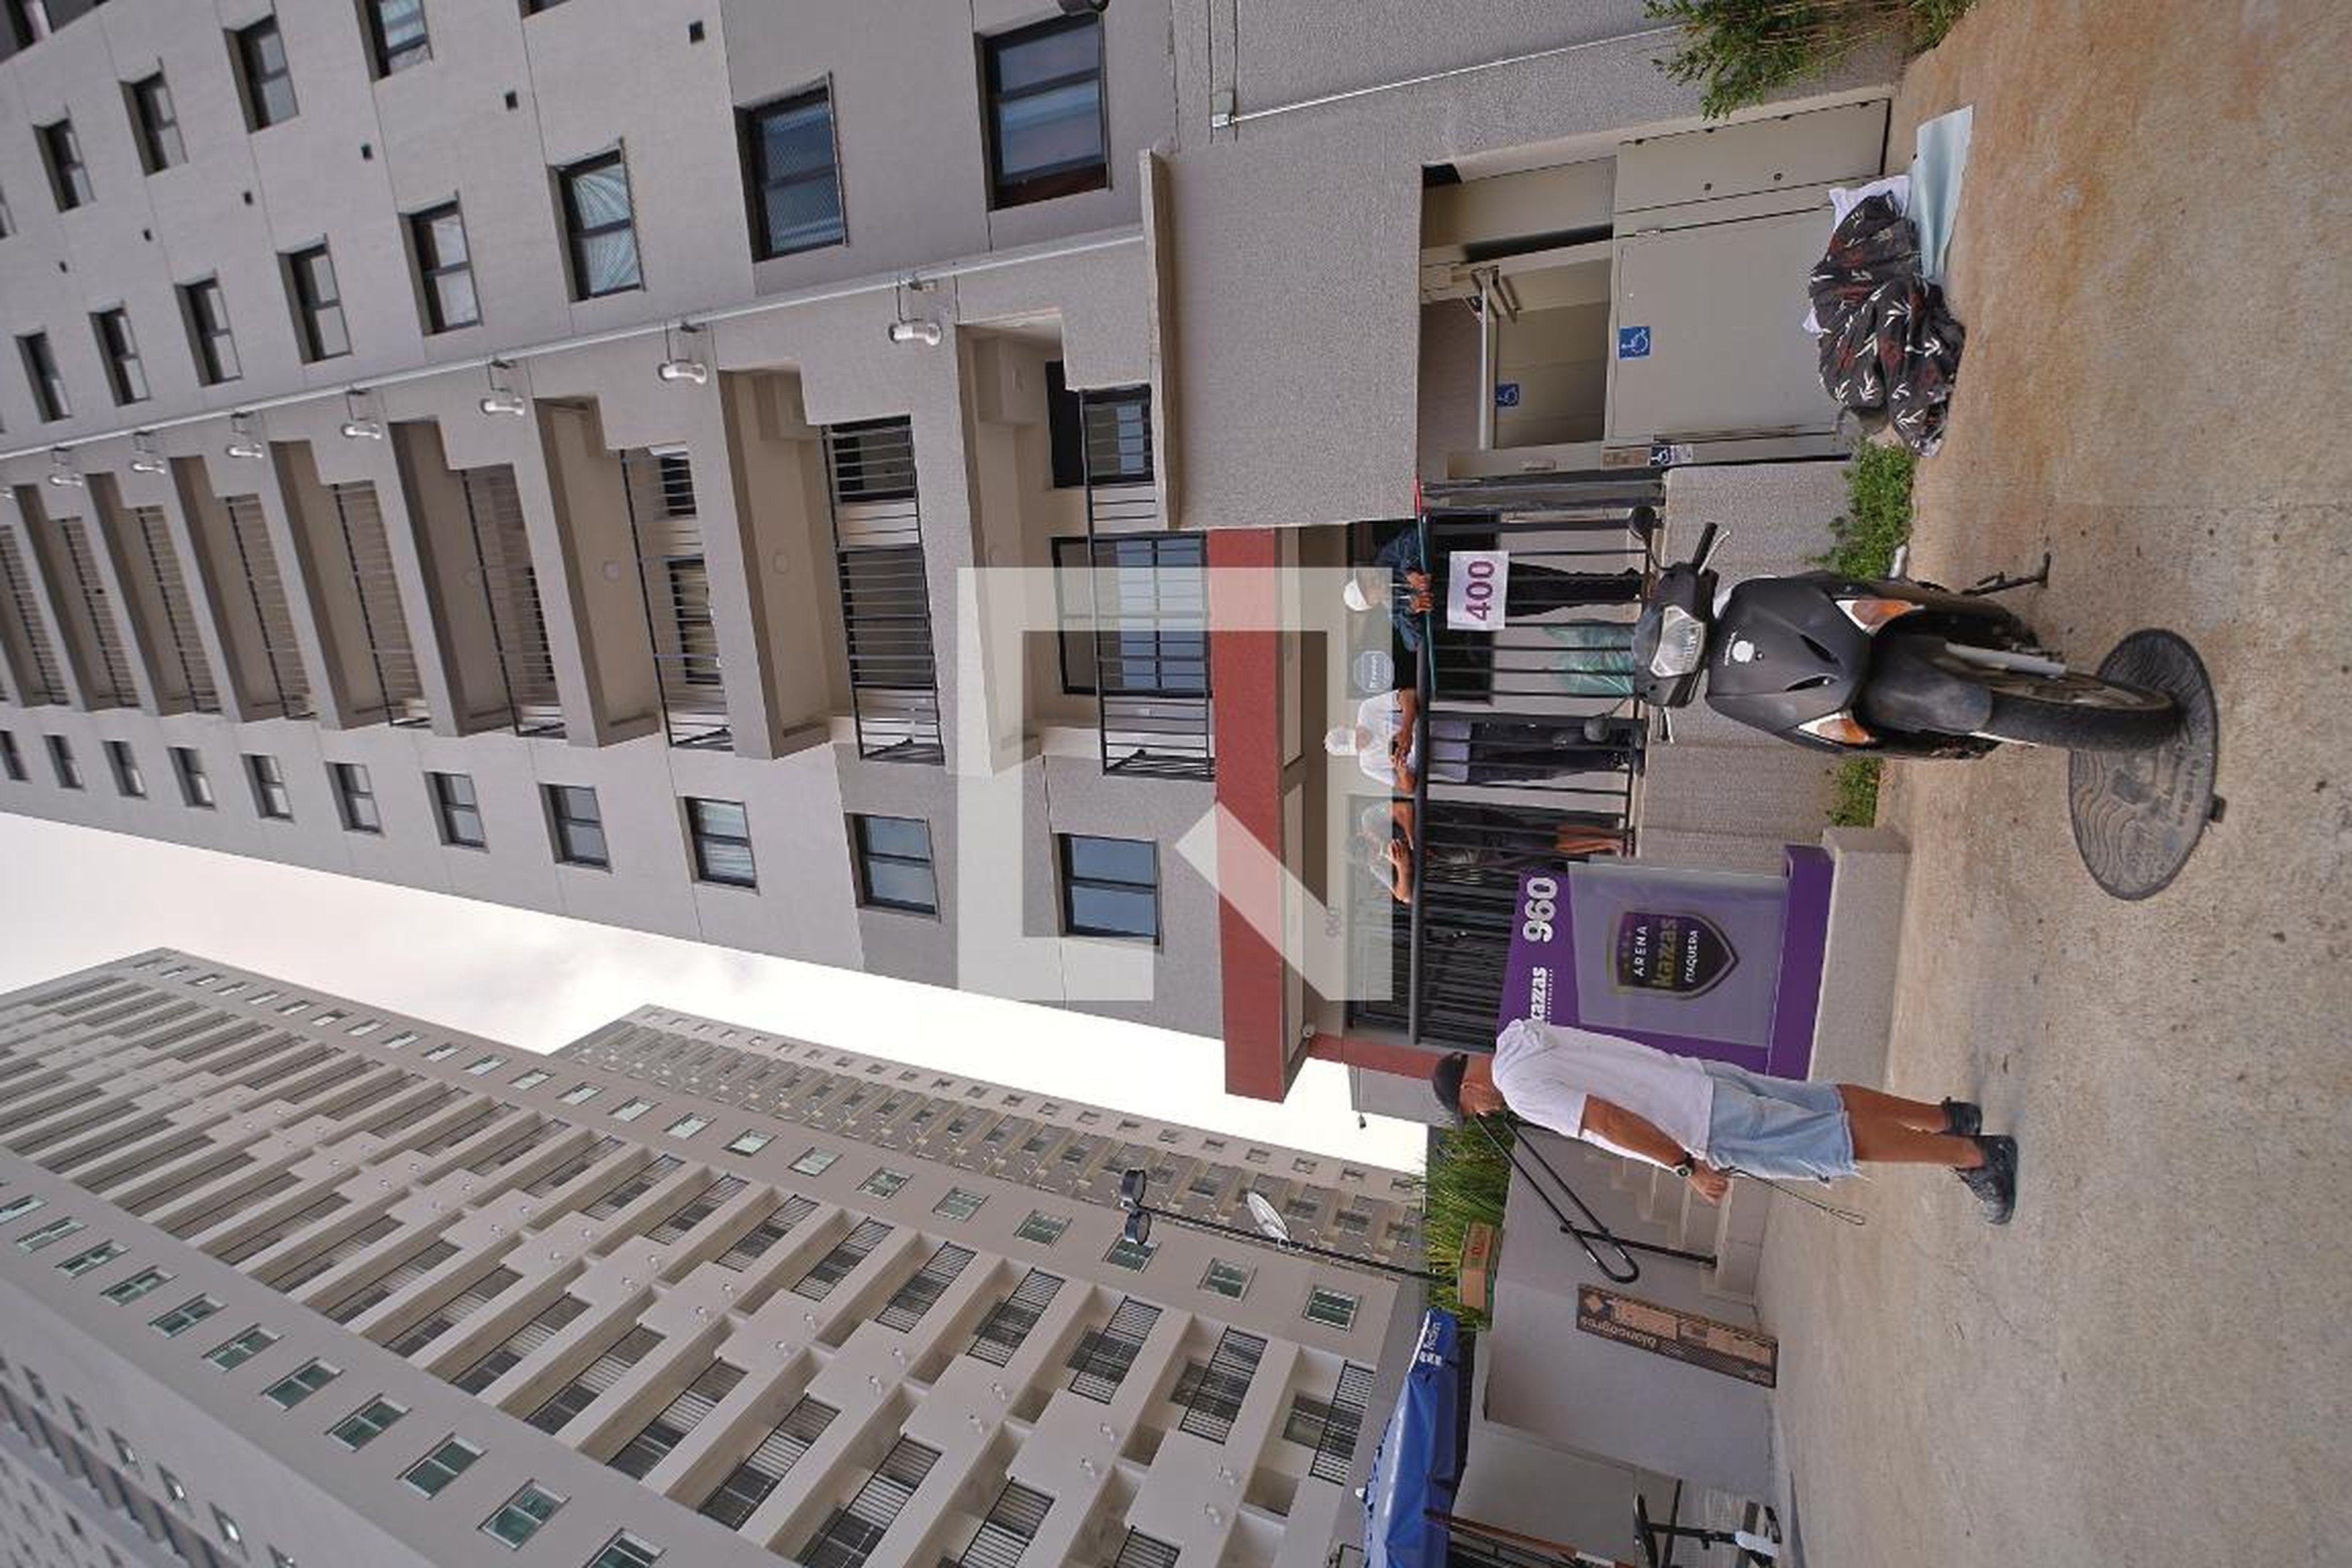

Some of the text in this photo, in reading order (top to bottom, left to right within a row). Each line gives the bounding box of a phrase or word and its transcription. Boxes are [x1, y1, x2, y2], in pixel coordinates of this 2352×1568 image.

[1465, 561, 1494, 621] 400
[1325, 907, 1342, 938] 960
[1523, 877, 1558, 942] 960
[1632, 925, 1648, 977] ARENA
[1684, 930, 1698, 982] ITAQUERA
